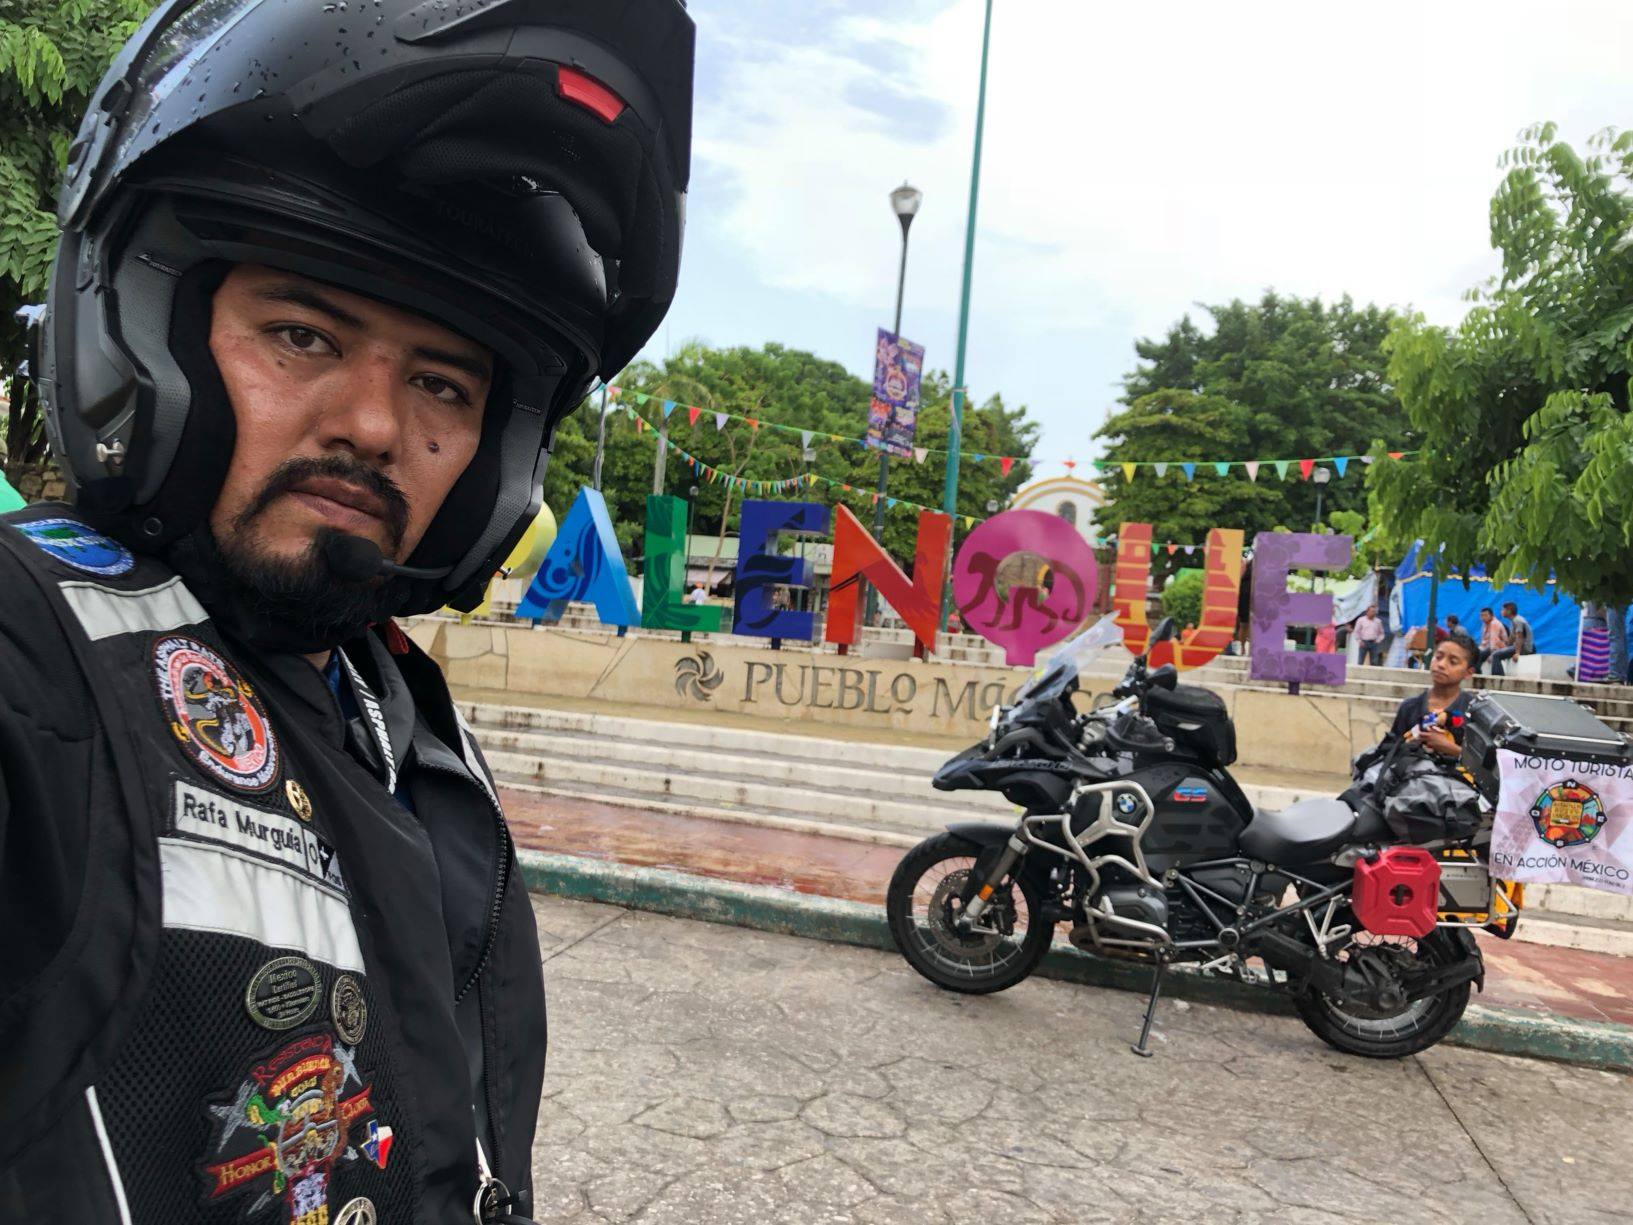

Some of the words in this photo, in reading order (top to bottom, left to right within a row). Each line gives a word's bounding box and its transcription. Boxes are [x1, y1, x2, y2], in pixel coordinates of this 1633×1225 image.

[742, 660, 918, 716] PUEBLO
[1514, 757, 1565, 771] MOTO
[183, 792, 229, 829] Rafa
[1495, 853, 1513, 866] EN
[1517, 854, 1568, 869] ACCIÓN
[1570, 859, 1629, 880] MÉXICO
